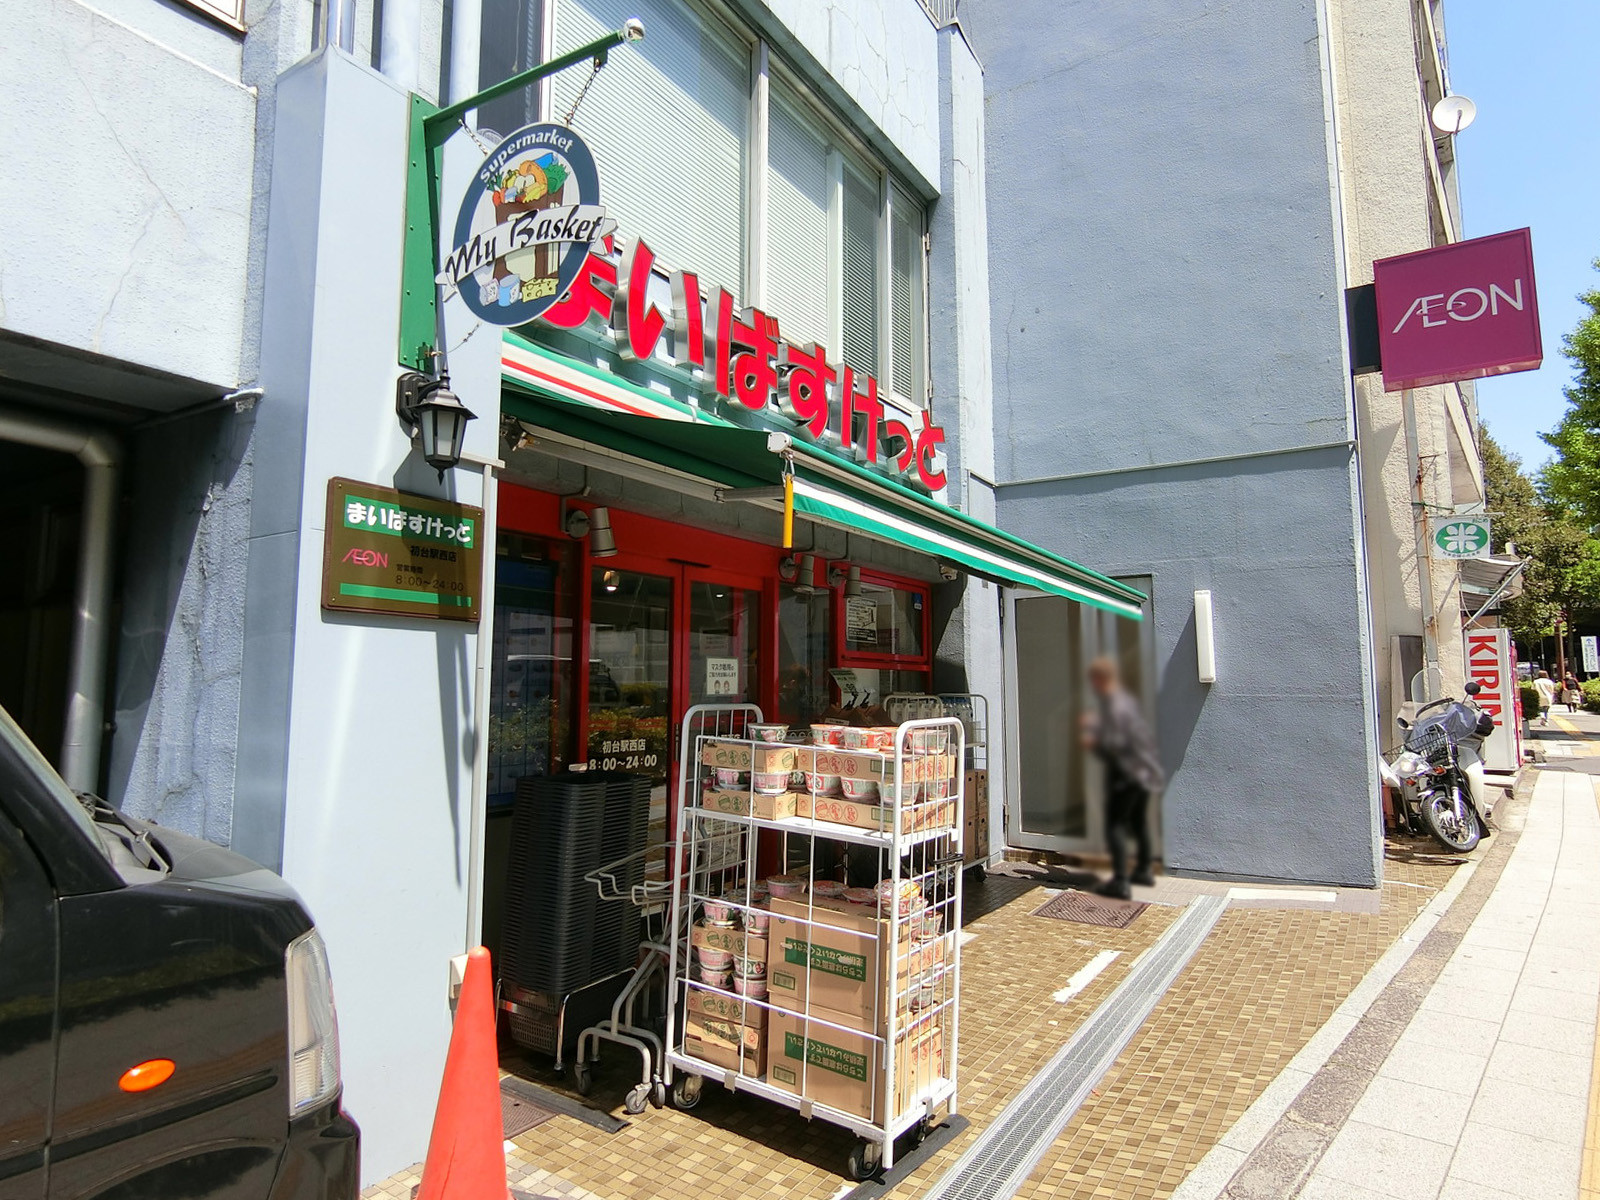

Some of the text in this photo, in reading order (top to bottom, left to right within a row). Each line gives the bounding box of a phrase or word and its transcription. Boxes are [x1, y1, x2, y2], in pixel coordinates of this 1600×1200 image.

[445, 205, 603, 283] My Basket
[1392, 279, 1524, 334] AEON
[346, 502, 472, 543] まいばすけっと
[342, 548, 389, 569] AEON
[602, 738, 646, 754] 初台駅西店
